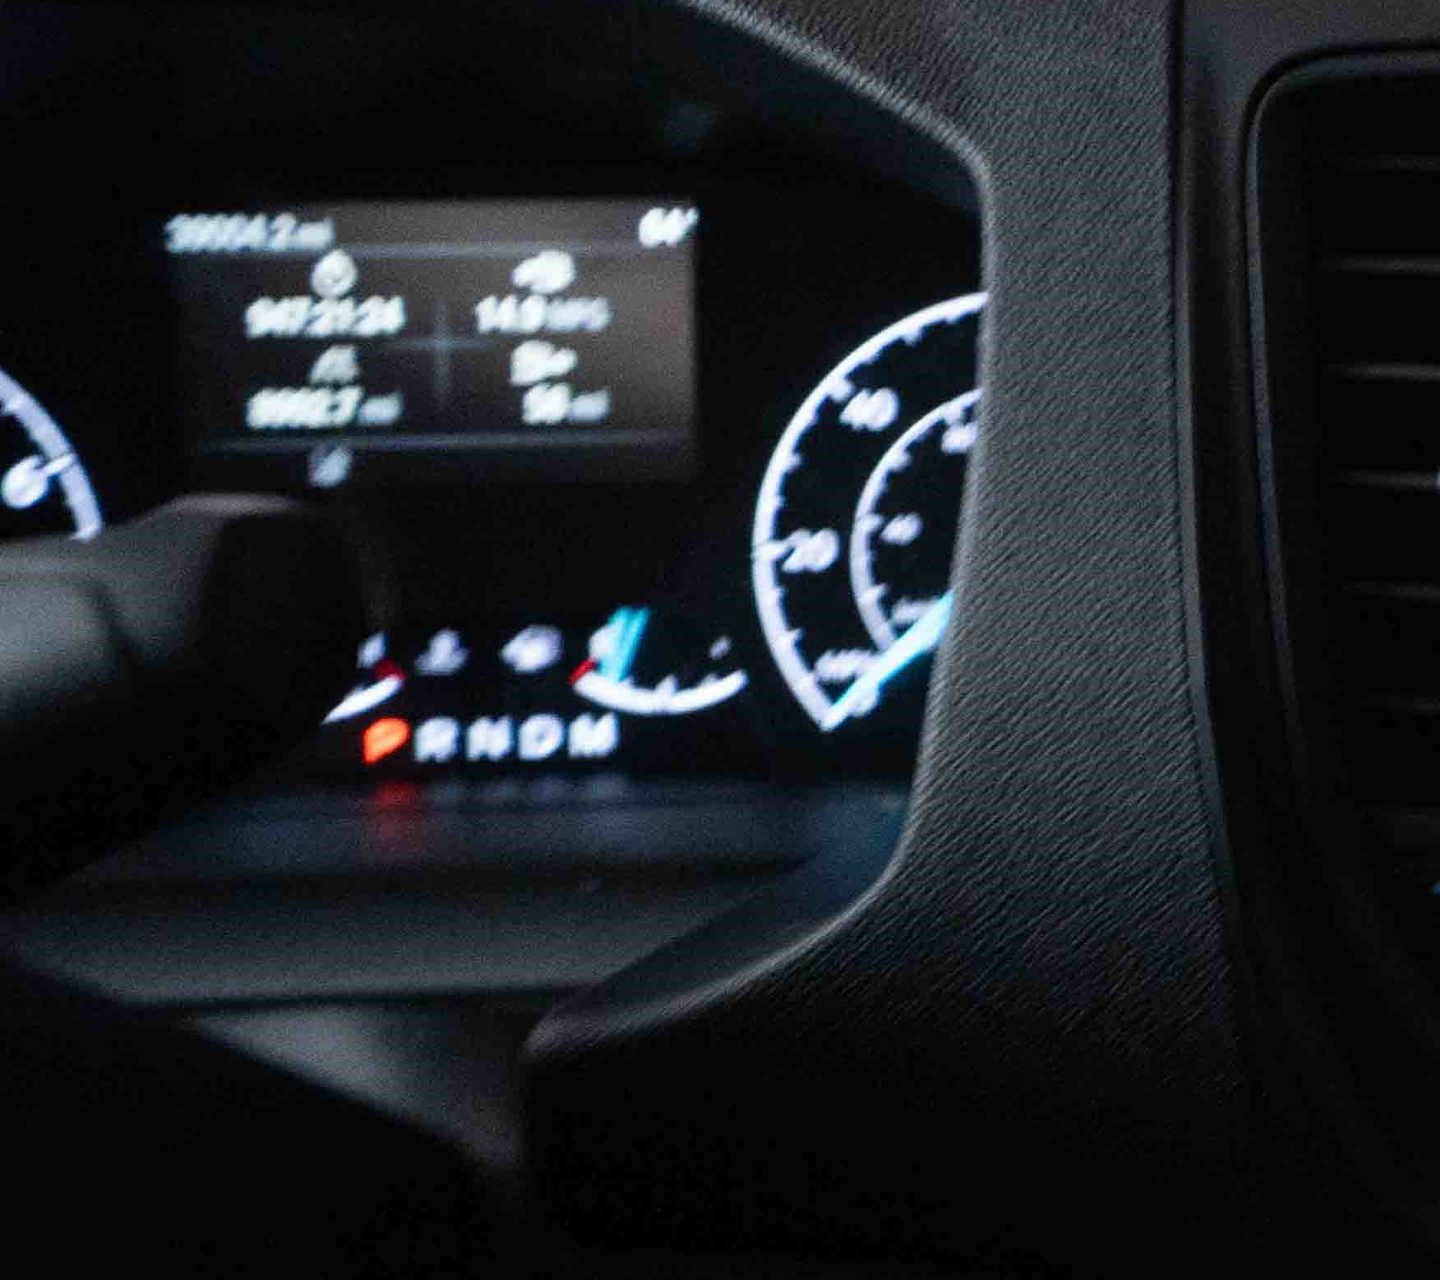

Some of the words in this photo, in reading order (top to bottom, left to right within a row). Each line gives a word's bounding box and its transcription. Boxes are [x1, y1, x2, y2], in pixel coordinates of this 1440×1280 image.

[782, 528, 841, 574] 20
[362, 716, 410, 766] P
[517, 712, 566, 761] D
